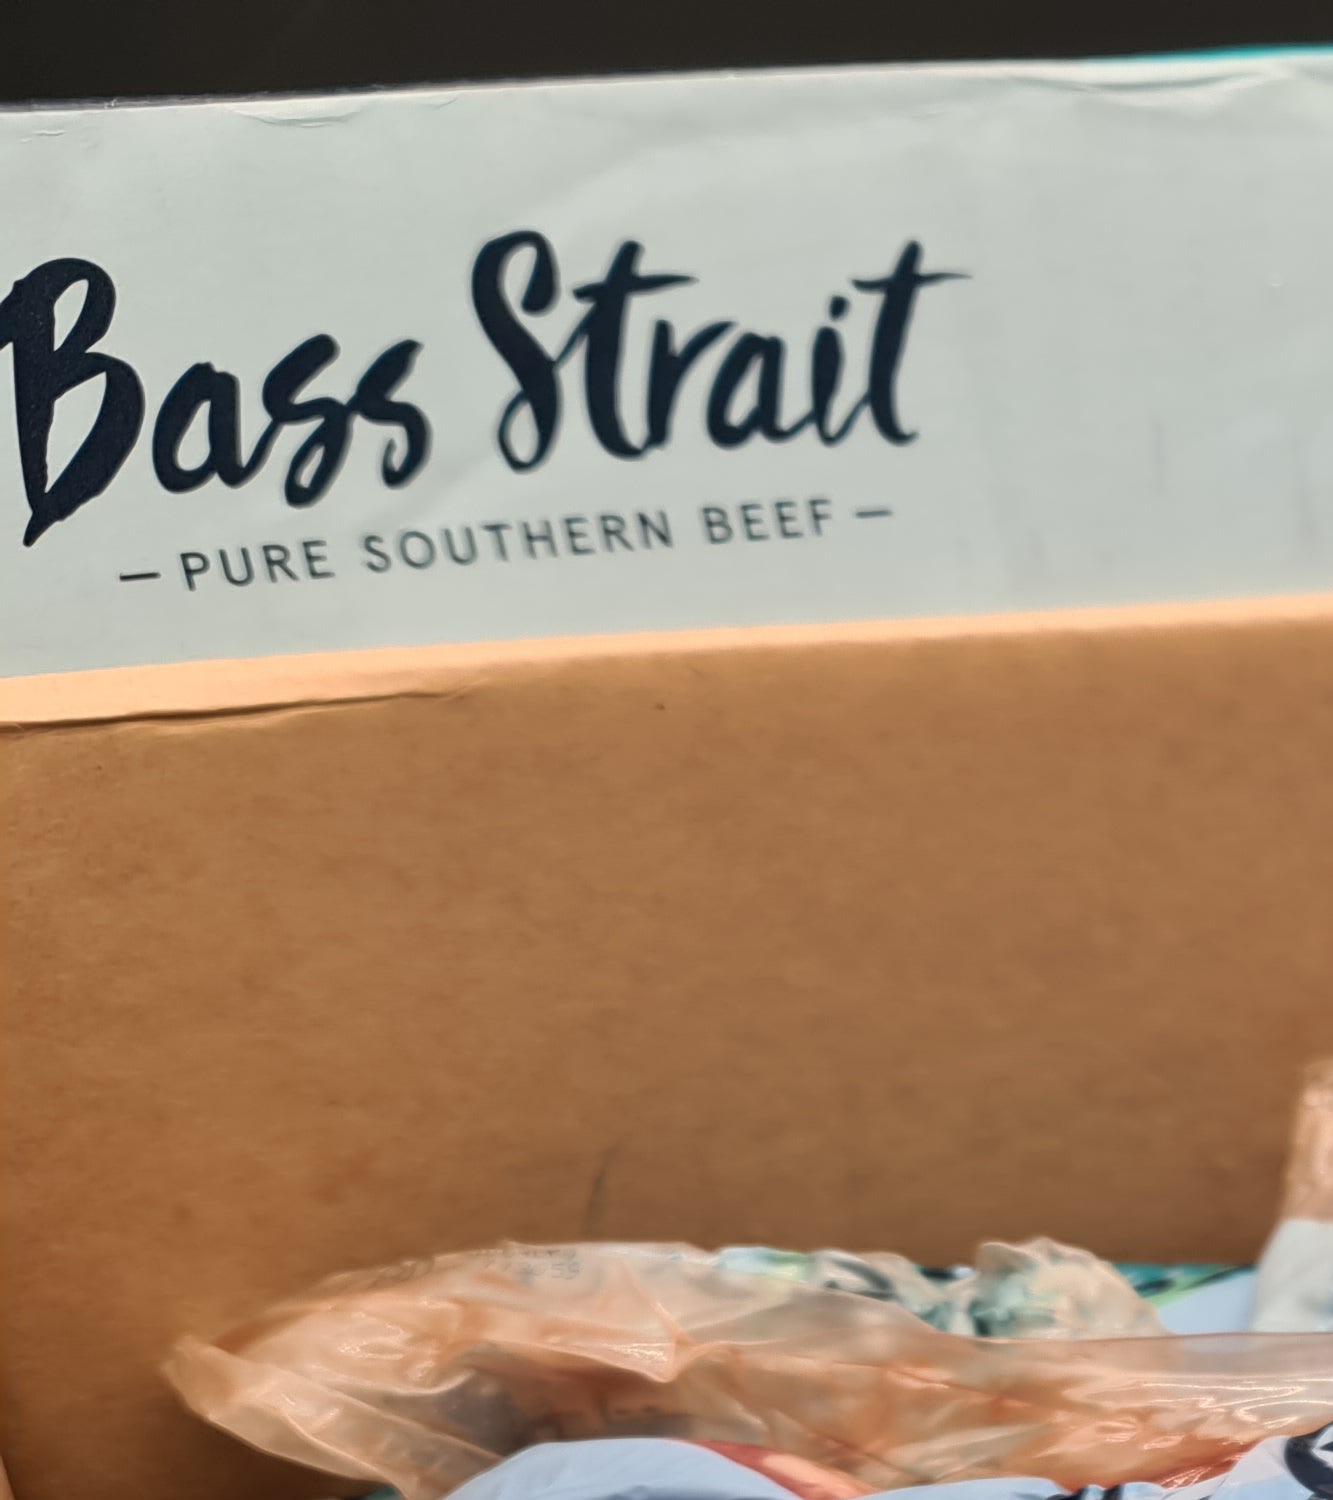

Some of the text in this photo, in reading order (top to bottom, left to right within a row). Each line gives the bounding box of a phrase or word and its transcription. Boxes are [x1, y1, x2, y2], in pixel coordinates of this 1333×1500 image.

[0, 230, 973, 547] Bass Strait
[365, 508, 673, 573] SOUTHERN
